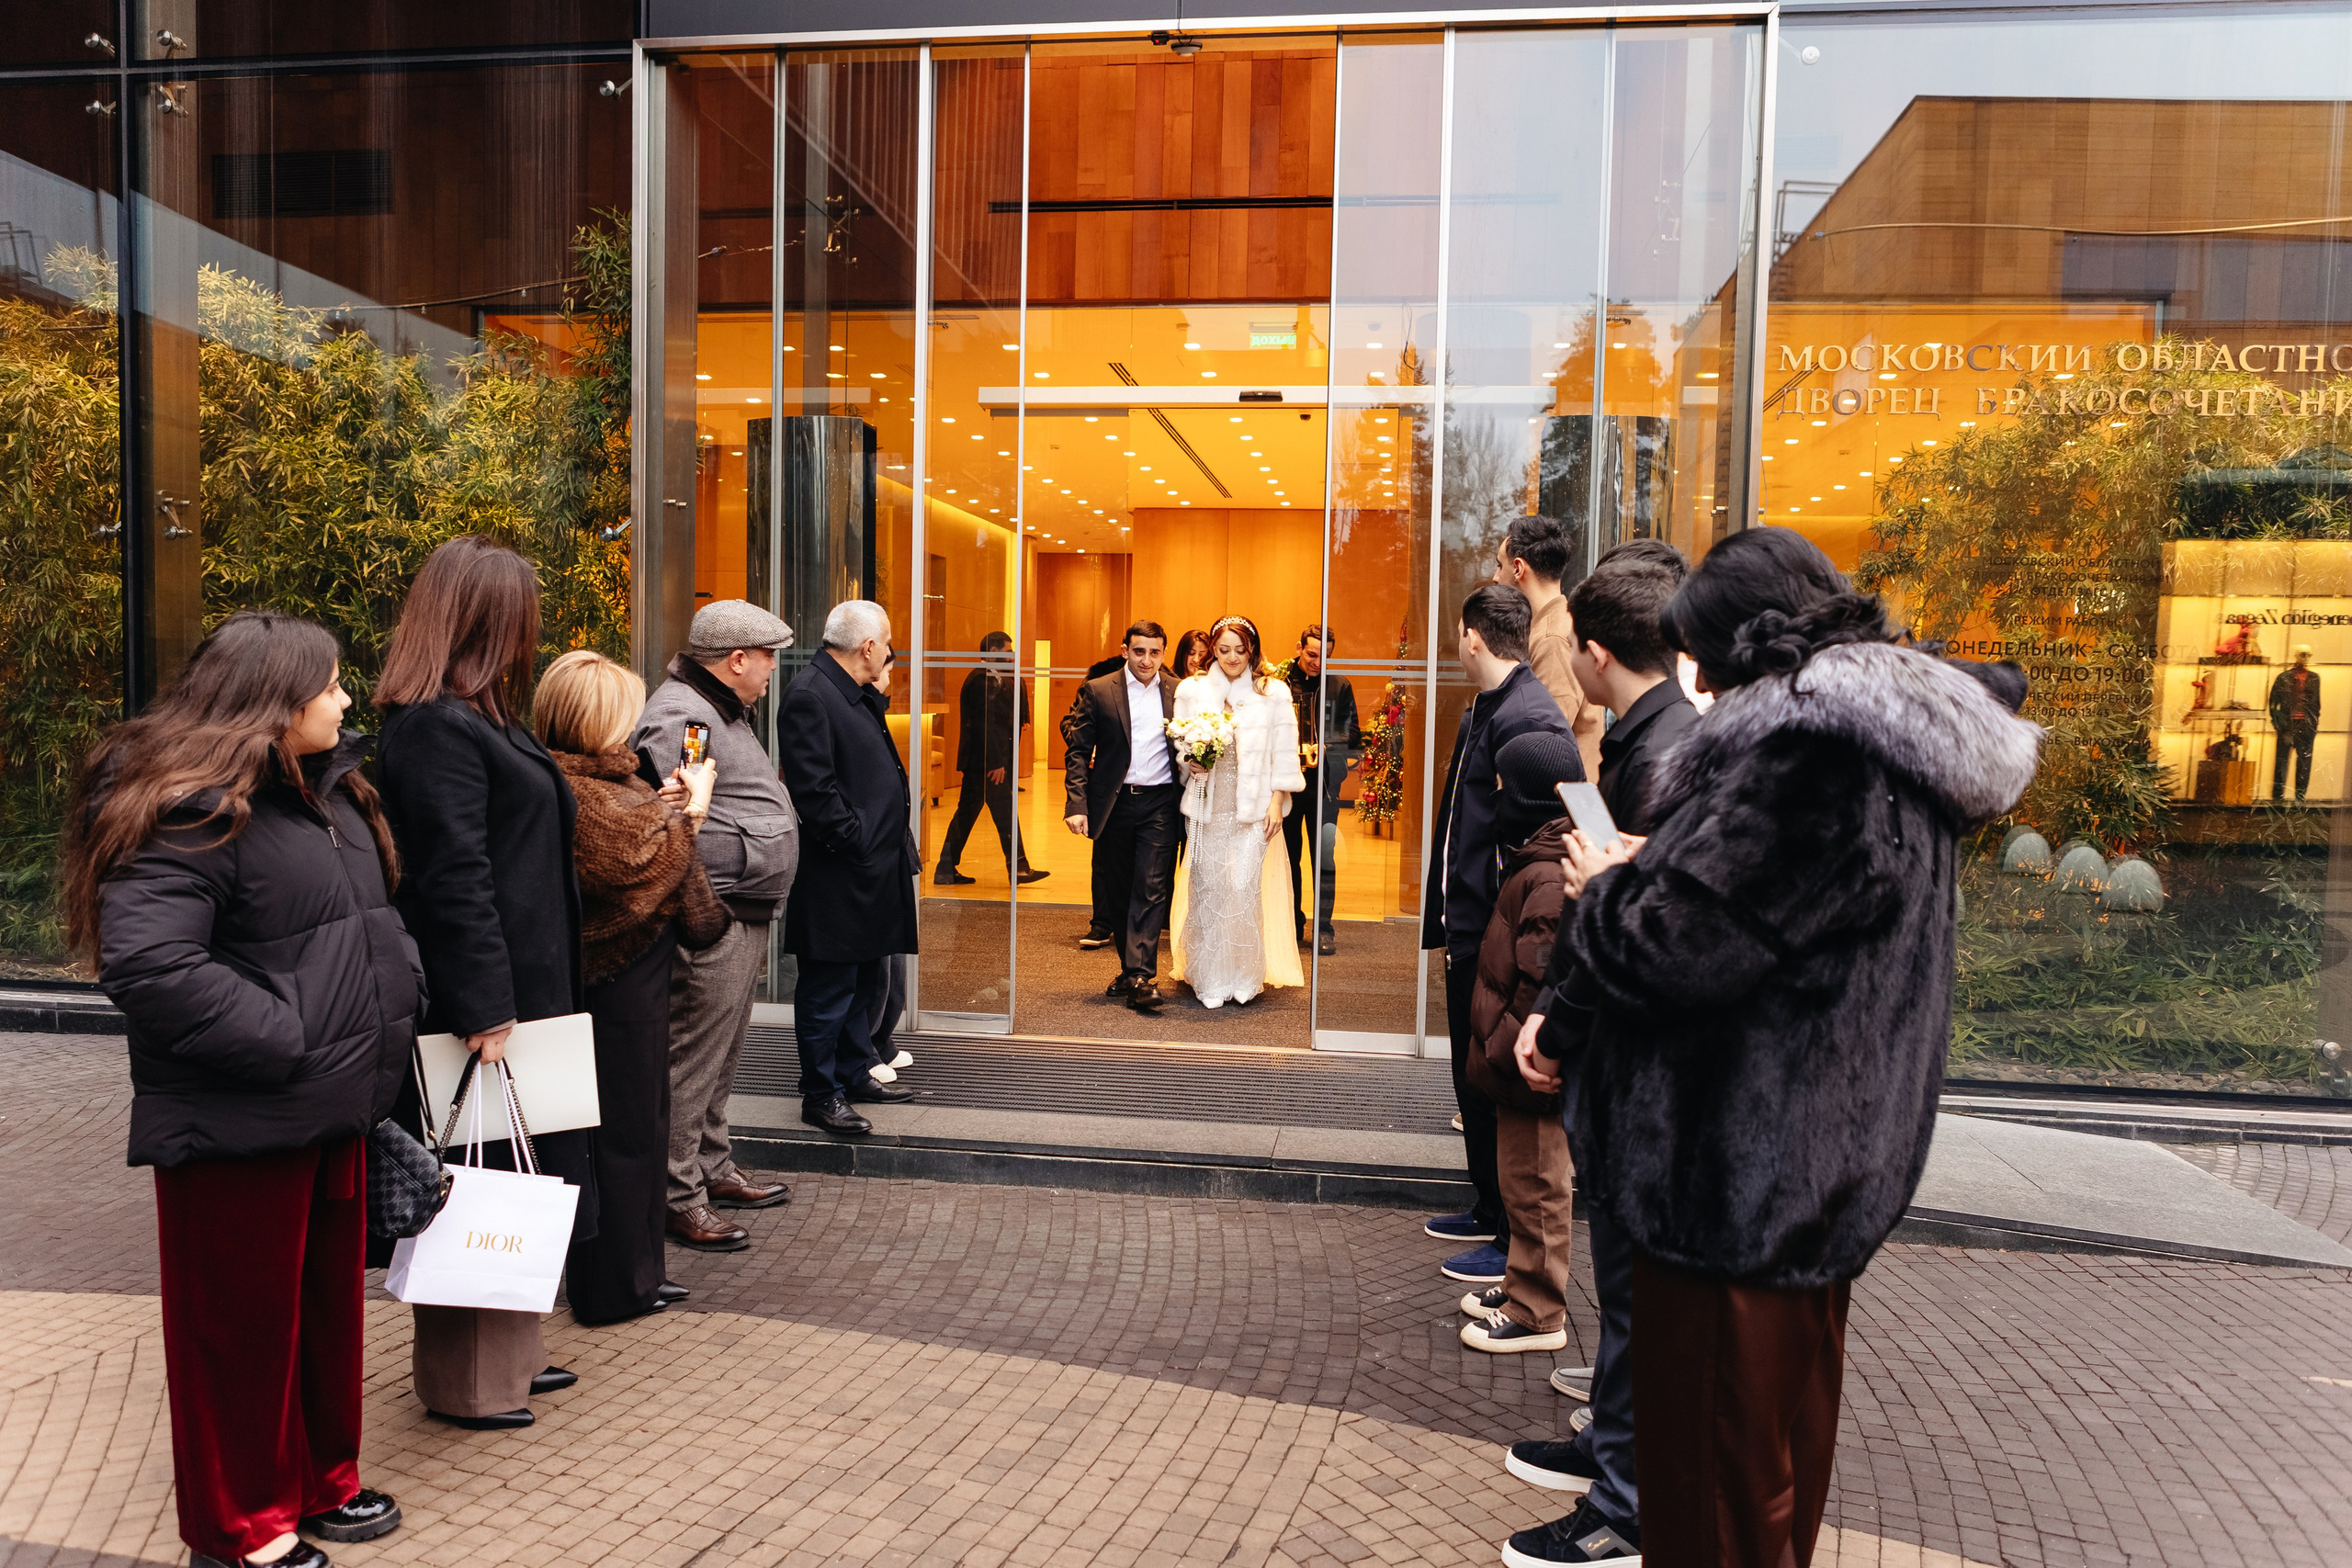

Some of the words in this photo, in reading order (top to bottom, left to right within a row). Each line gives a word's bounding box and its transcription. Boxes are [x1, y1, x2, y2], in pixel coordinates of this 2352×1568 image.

[1777, 387, 1941, 421] ДВОРЕЦ
[1983, 556, 2075, 568] МОСКОВСКИЙ
[2030, 586, 2074, 597] ОТДЕЛ
[2014, 615, 2062, 626] РЕЖИМ
[2066, 616, 2117, 627] РАБОТЫ
[1945, 640, 2087, 658] ОНЕДЕЛЬНИК
[2108, 644, 2199, 660] СУББОТА
[2057, 666, 2089, 683] ДО
[2096, 667, 2144, 682] 19:00
[2029, 691, 2080, 703] ЧЕСКИЙ
[2084, 693, 2142, 705] ПЕРЕРЫВ
[2026, 706, 2055, 716] 13:00
[2057, 707, 2077, 717] ДО
[466, 1231, 523, 1254] DIOR
